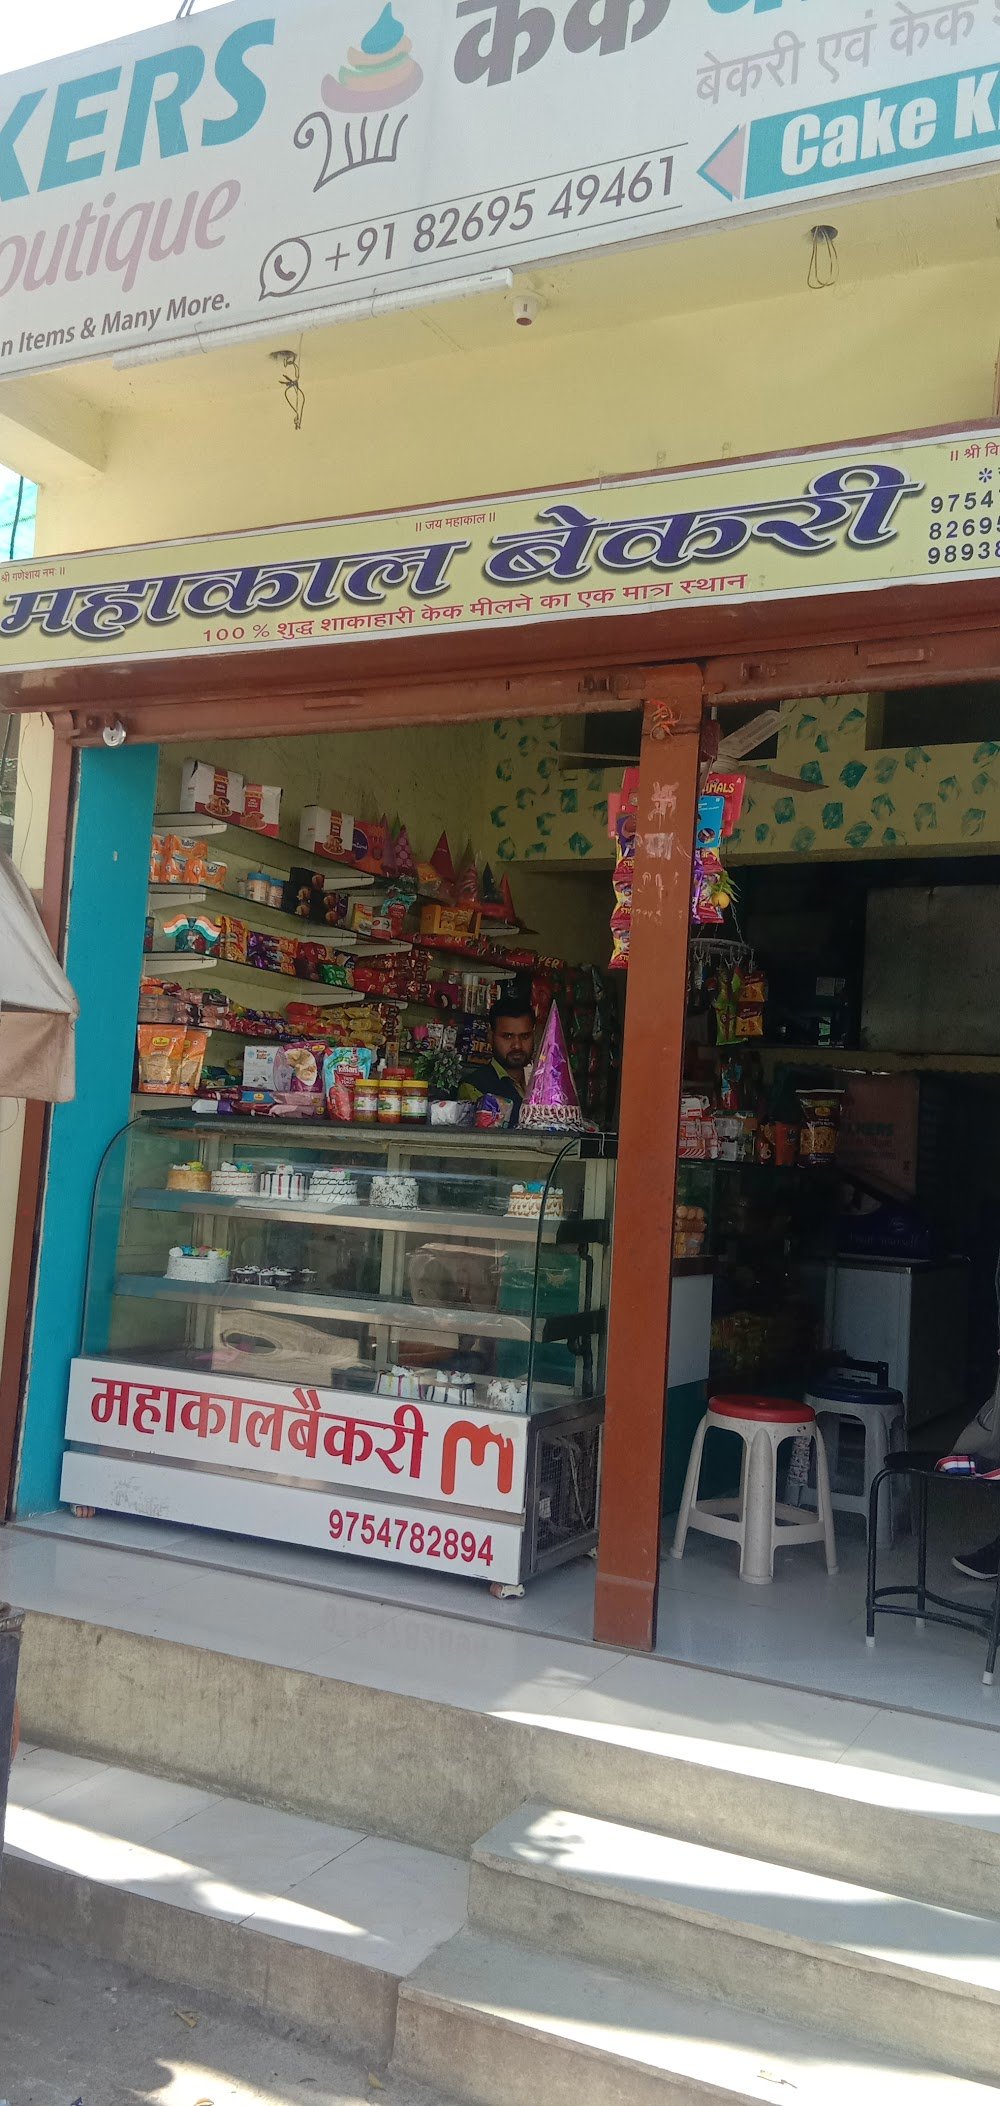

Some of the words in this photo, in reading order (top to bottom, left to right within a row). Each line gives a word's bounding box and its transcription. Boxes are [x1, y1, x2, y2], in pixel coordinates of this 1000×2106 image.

[697, 30, 806, 104] बेकरी
[817, 9, 877, 84] एवं
[889, 0, 978, 56] केक
[780, 97, 937, 177] Cake
[954, 71, 1000, 139] K
[325, 224, 395, 272] +91
[413, 188, 537, 253] 82695
[548, 156, 674, 220] 49461
[18, 326, 75, 353] Items
[80, 317, 95, 339] &
[101, 306, 162, 331] Many
[166, 293, 230, 321] More.
[963, 443, 981, 459] श्री
[425, 518, 442, 530] जय
[445, 513, 486, 528] महाकाल
[930, 490, 1000, 514] 9754
[0, 539, 468, 640] महाकाल
[482, 464, 926, 583] बेकरी
[12, 569, 41, 581] गणेशाय
[203, 627, 245, 642] 100
[252, 623, 270, 639] %
[277, 620, 315, 640] शुद्ध
[321, 606, 416, 632] शाकाहारी
[421, 603, 463, 622] केक
[470, 596, 534, 615] मीलने
[540, 592, 570, 609] का
[577, 587, 616, 607] एक
[623, 582, 673, 601] मात्र
[680, 573, 749, 594] स्थान
[91, 1378, 429, 1479] महाकालबैकरी
[328, 1508, 494, 1567] 9754782894
